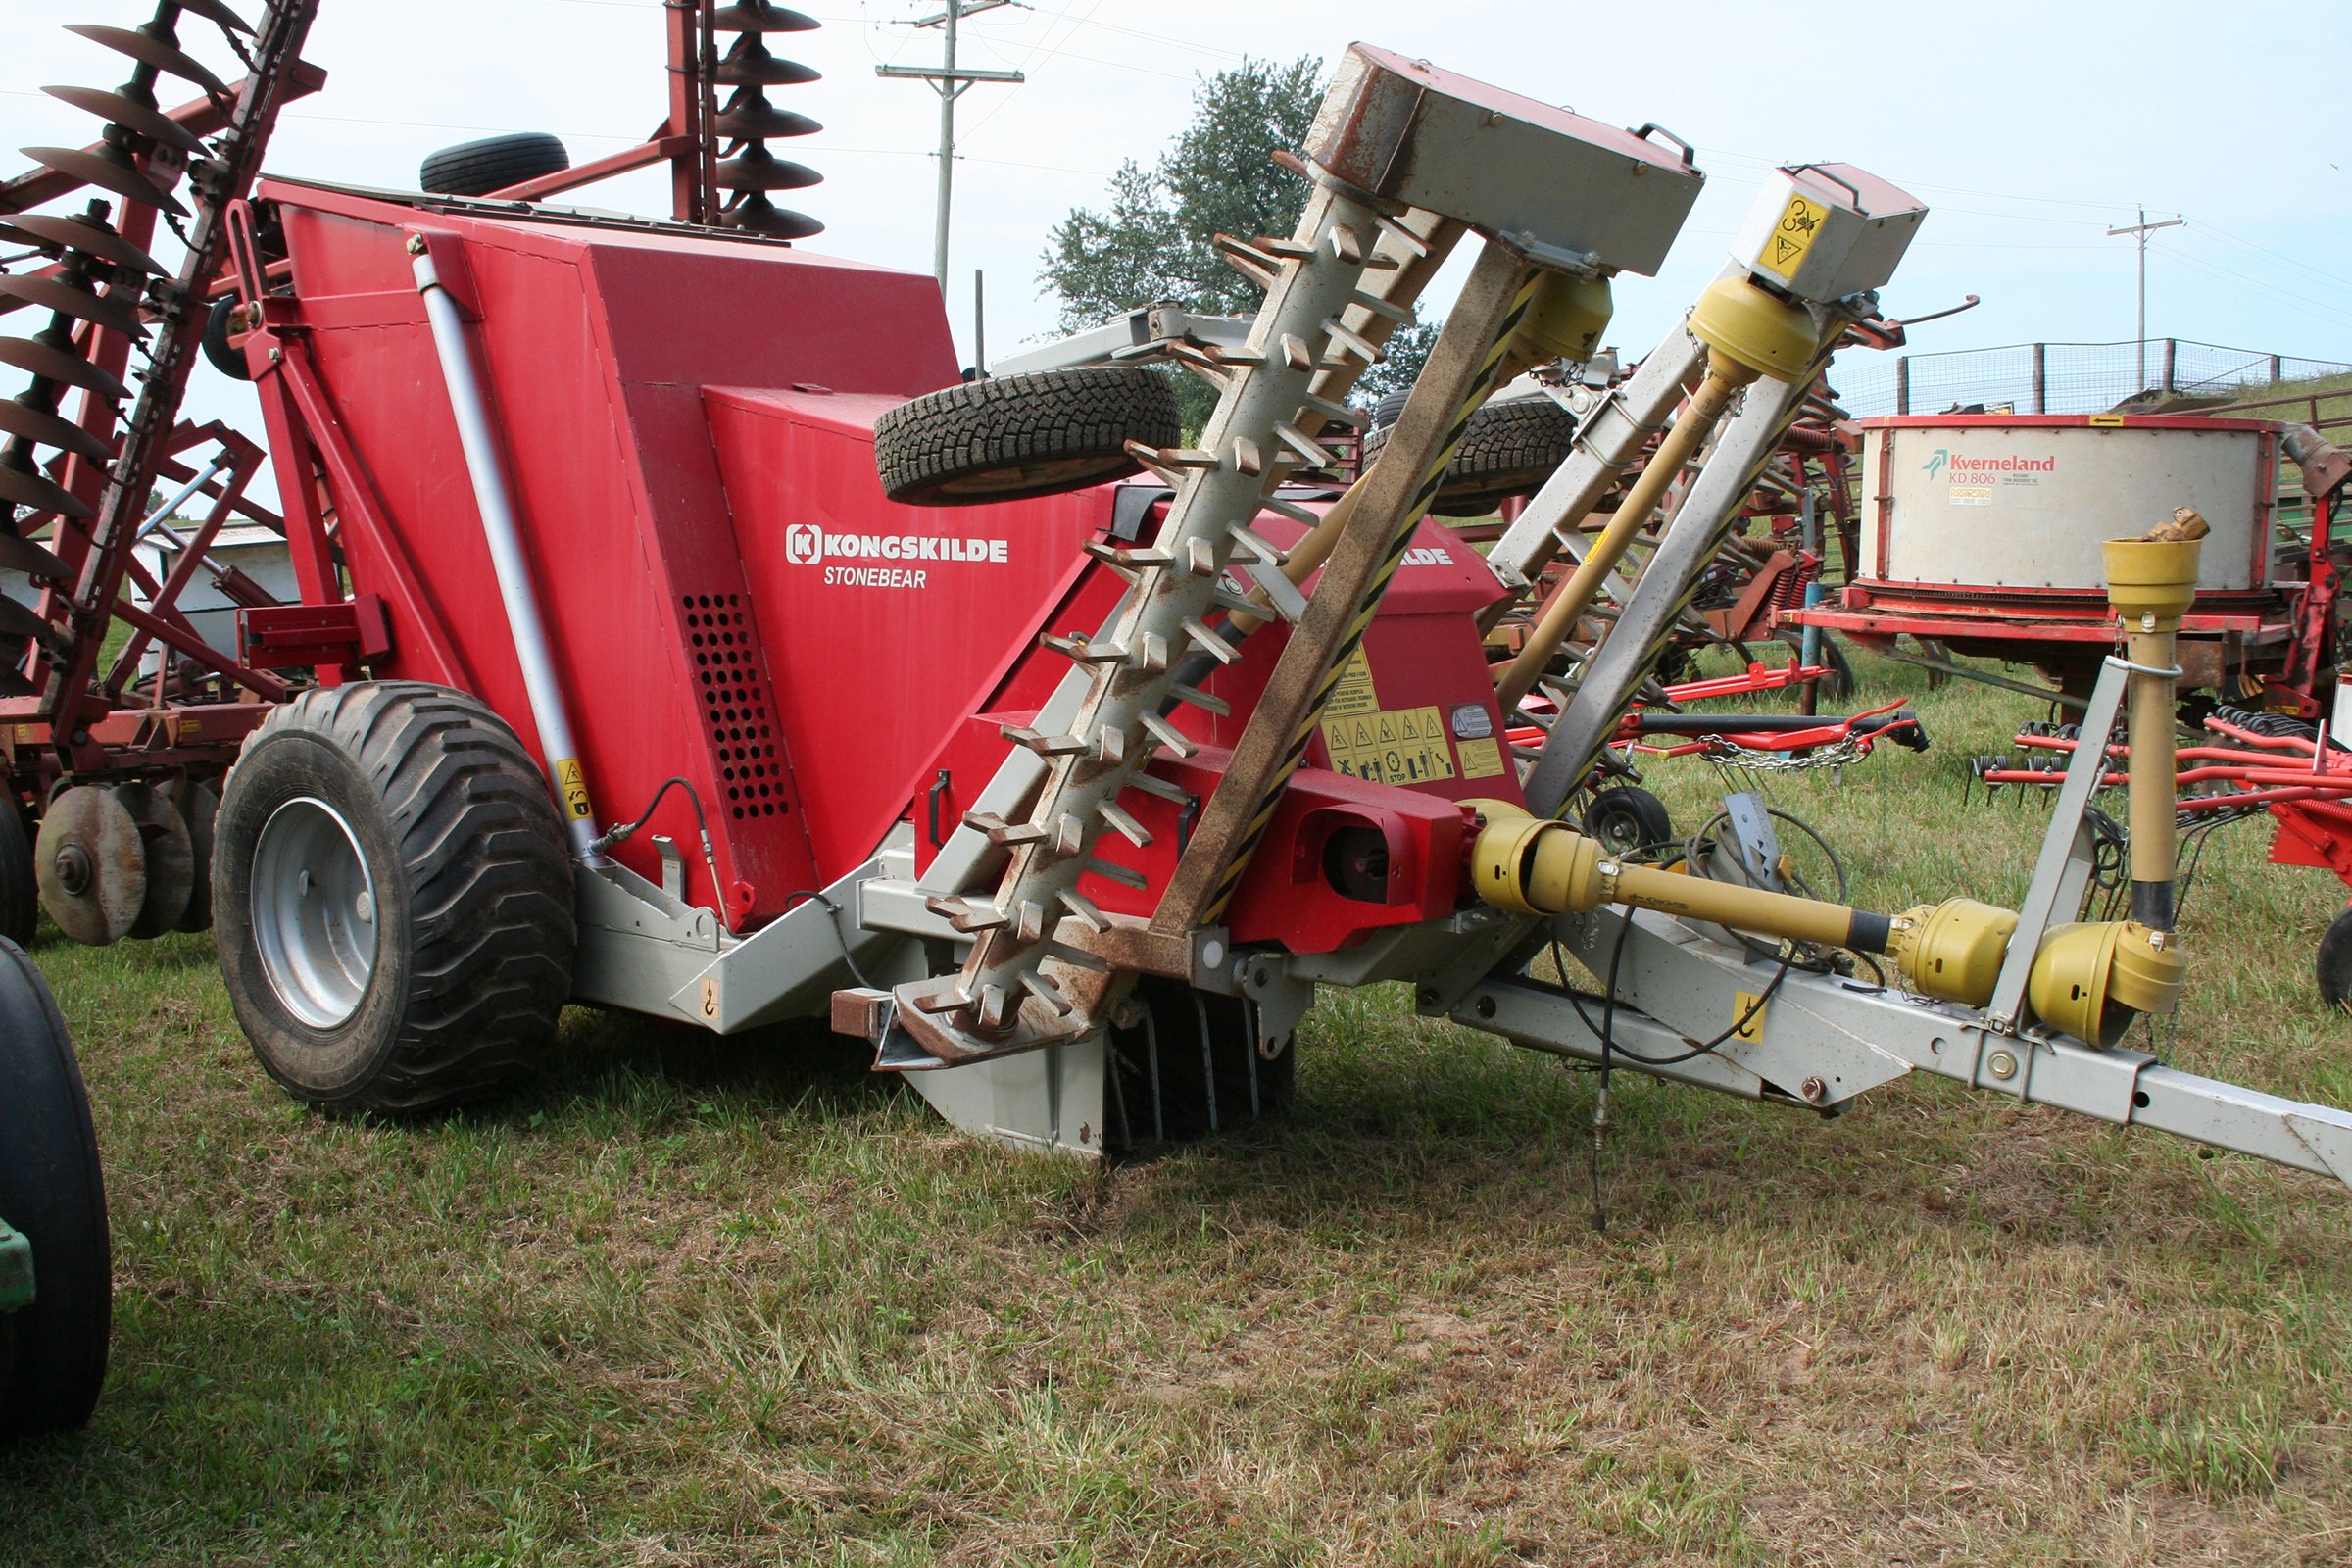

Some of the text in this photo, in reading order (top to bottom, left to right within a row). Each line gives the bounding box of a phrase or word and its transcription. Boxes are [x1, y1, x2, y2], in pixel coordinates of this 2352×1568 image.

[1950, 454, 2055, 471] Kverneland
[1949, 473, 1967, 484] KD
[1970, 473, 1995, 484] 806
[824, 534, 1008, 563] KONGSKILDE
[824, 566, 927, 589] STONEBEAR
[1390, 773, 1406, 783] STOP
